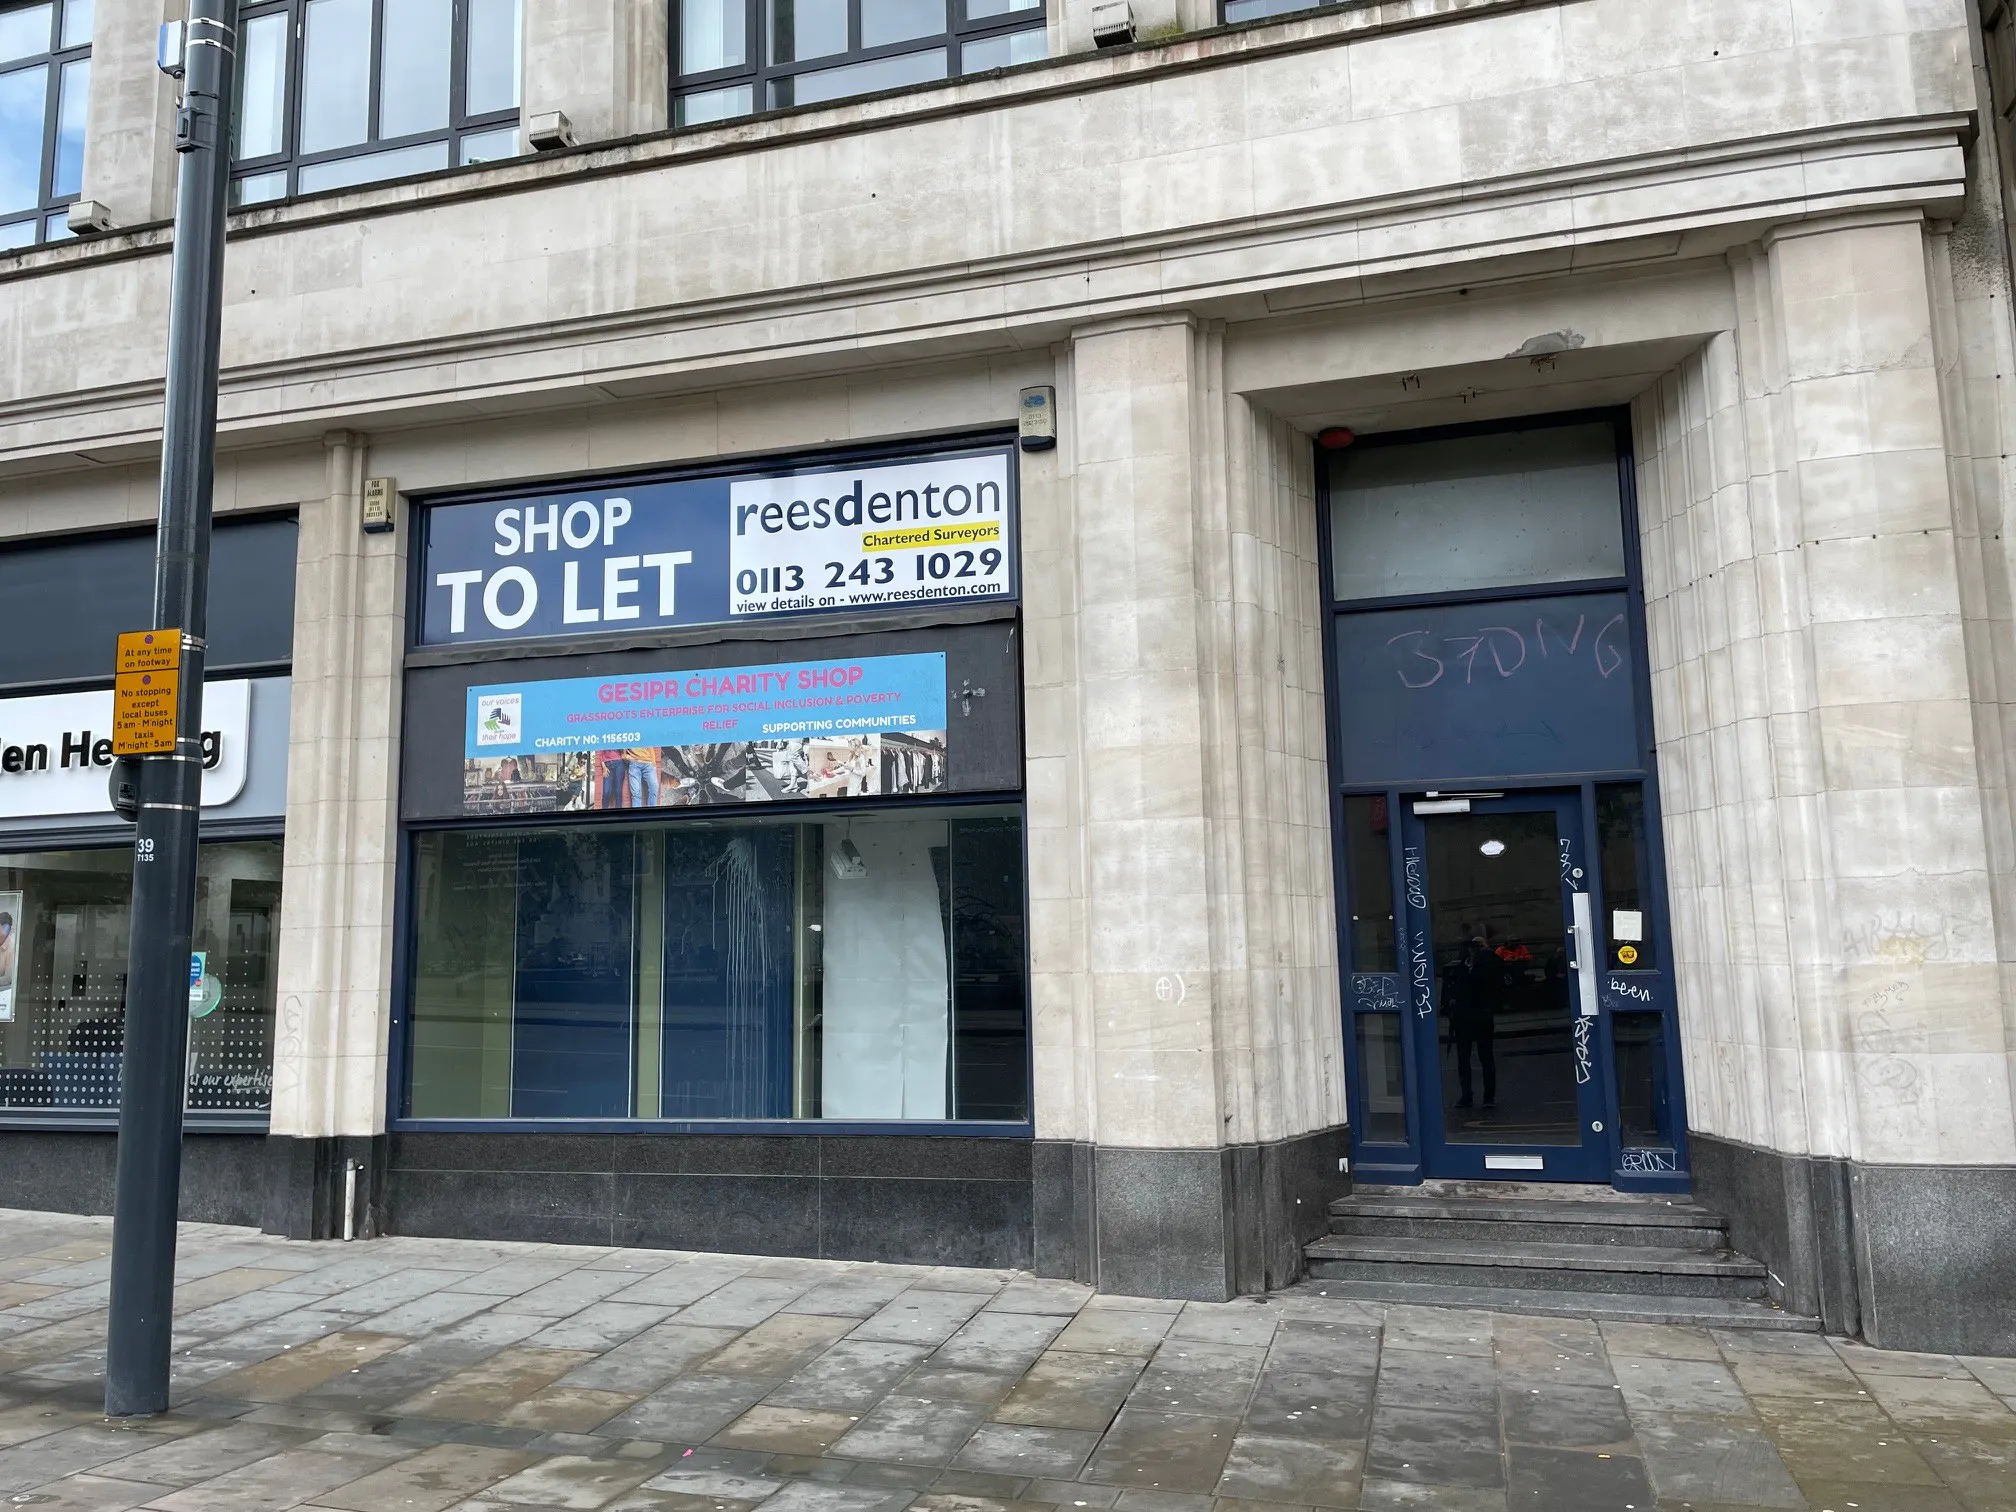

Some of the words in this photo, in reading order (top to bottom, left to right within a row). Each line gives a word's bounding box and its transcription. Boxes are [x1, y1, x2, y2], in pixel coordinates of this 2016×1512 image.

[736, 480, 1000, 536] reesdenton
[494, 497, 632, 556] SHOP
[863, 530, 930, 547] Chartered
[934, 526, 1000, 543] Surveyors
[736, 565, 805, 596] 0113
[824, 557, 894, 589] 243
[916, 548, 1002, 581] 1029
[436, 565, 538, 634] TO
[563, 550, 692, 625] LET
[737, 600, 767, 613] view
[771, 594, 815, 610] details
[818, 596, 835, 606] on
[849, 583, 1001, 604] www.reesdenton.com
[125, 649, 135, 657] At
[137, 648, 151, 658] any
[138, 658, 171, 667] footway
[121, 689, 133, 697] No
[136, 687, 171, 698] stopping
[597, 679, 679, 704] GESIPR
[685, 672, 791, 698] CHARITY
[798, 666, 863, 690] SHOP
[123, 711, 142, 719] local
[144, 708, 168, 717] buses
[132, 700, 159, 709] except
[566, 710, 637, 723] GRASSROOTS
[640, 706, 704, 719] ENTERPRISE
[708, 704, 730, 714] FOR
[732, 701, 770, 712] SOCIAL
[774, 697, 833, 709] INCLUSION
[836, 695, 844, 705] &
[847, 692, 901, 704] POVERTY
[702, 719, 739, 731] RELIEF
[762, 721, 833, 734] SUPPORTING
[835, 715, 916, 730] COMMUNITIES
[535, 737, 579, 748] CHARITY
[602, 732, 641, 744] 1156503
[138, 838, 154, 853] 39
[137, 853, 154, 862] T135
[203, 1074, 222, 1086] our
[224, 1068, 273, 1093] expertise
